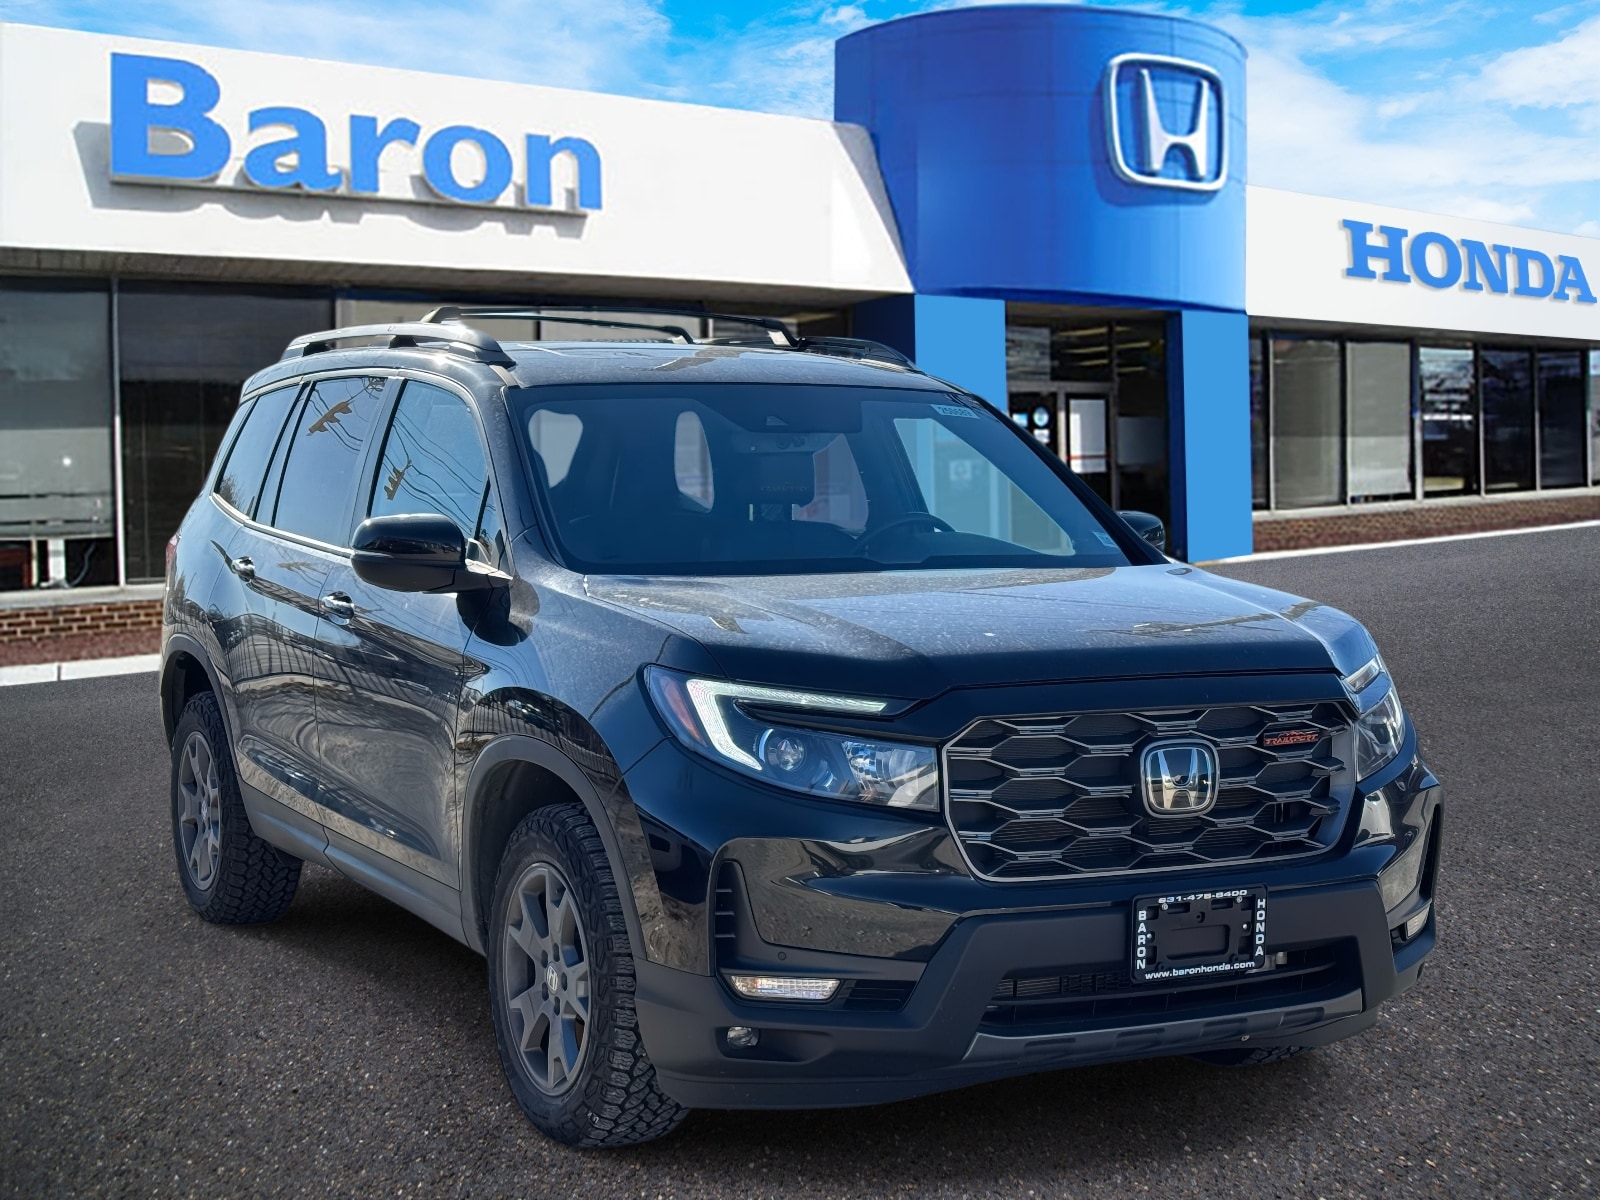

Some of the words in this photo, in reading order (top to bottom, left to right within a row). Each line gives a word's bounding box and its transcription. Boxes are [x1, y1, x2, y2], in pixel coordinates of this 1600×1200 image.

[110, 51, 603, 211] Baron
[1341, 218, 1598, 305] HONDA
[1136, 910, 1147, 970] BARON
[1254, 898, 1266, 957] HONDA
[1144, 960, 1256, 980] www.baronhonda.com
